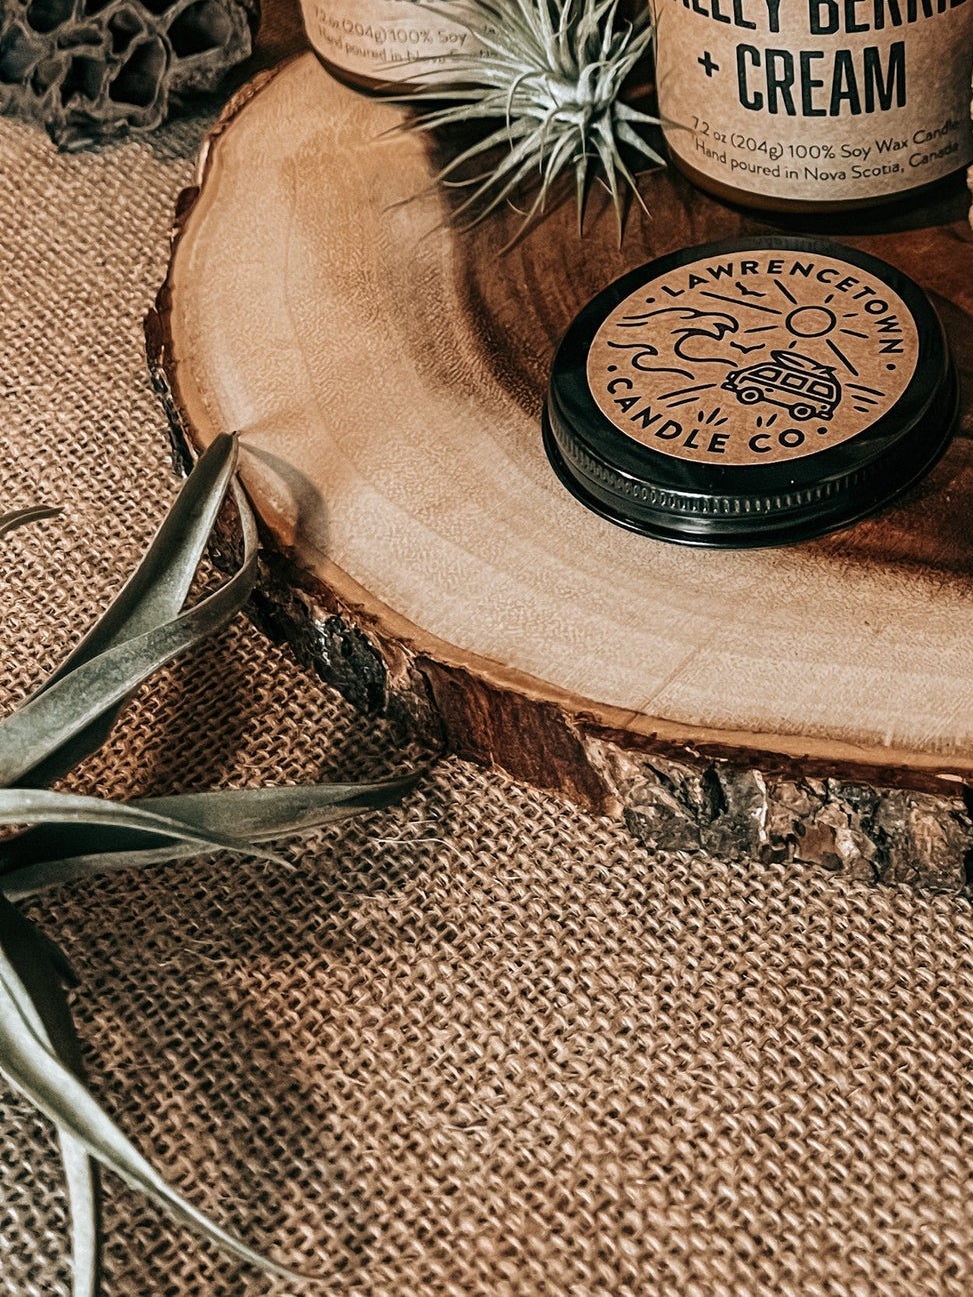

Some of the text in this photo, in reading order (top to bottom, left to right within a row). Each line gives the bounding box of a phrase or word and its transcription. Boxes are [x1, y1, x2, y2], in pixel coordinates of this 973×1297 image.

[387, 28, 434, 45] 100%
[437, 30, 468, 48] Soy
[736, 41, 907, 118] CREAM
[695, 137, 960, 181] Hand poured in Nova Scotia, Canada
[713, 131, 728, 144] oz
[731, 133, 784, 161] (204g)
[788, 144, 836, 160] 100%
[841, 144, 871, 161] Soy
[875, 138, 909, 154] Wax
[913, 118, 960, 145] Candle
[660, 259, 905, 355] LAWRENCETOWN
[607, 377, 731, 454] CANDLE
